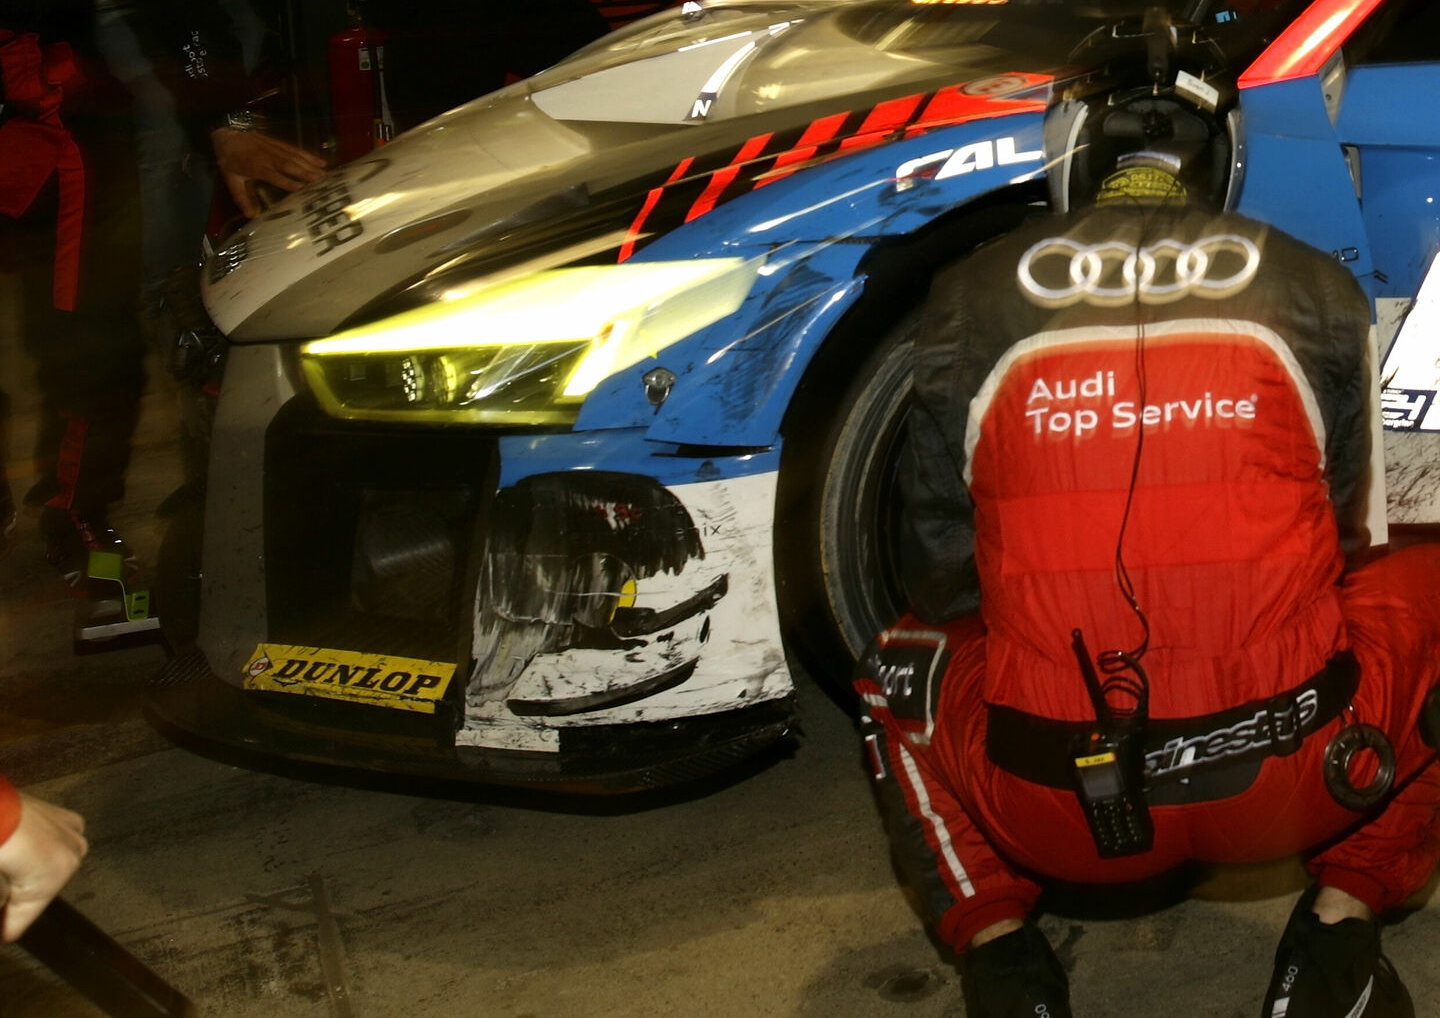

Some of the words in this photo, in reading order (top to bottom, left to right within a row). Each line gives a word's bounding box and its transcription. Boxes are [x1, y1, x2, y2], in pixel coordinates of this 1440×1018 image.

[691, 99, 712, 118] N
[1027, 370, 1116, 406] Audi
[1025, 407, 1099, 437] Top
[1112, 393, 1257, 429] Service
[277, 658, 442, 696] DUNLOP
